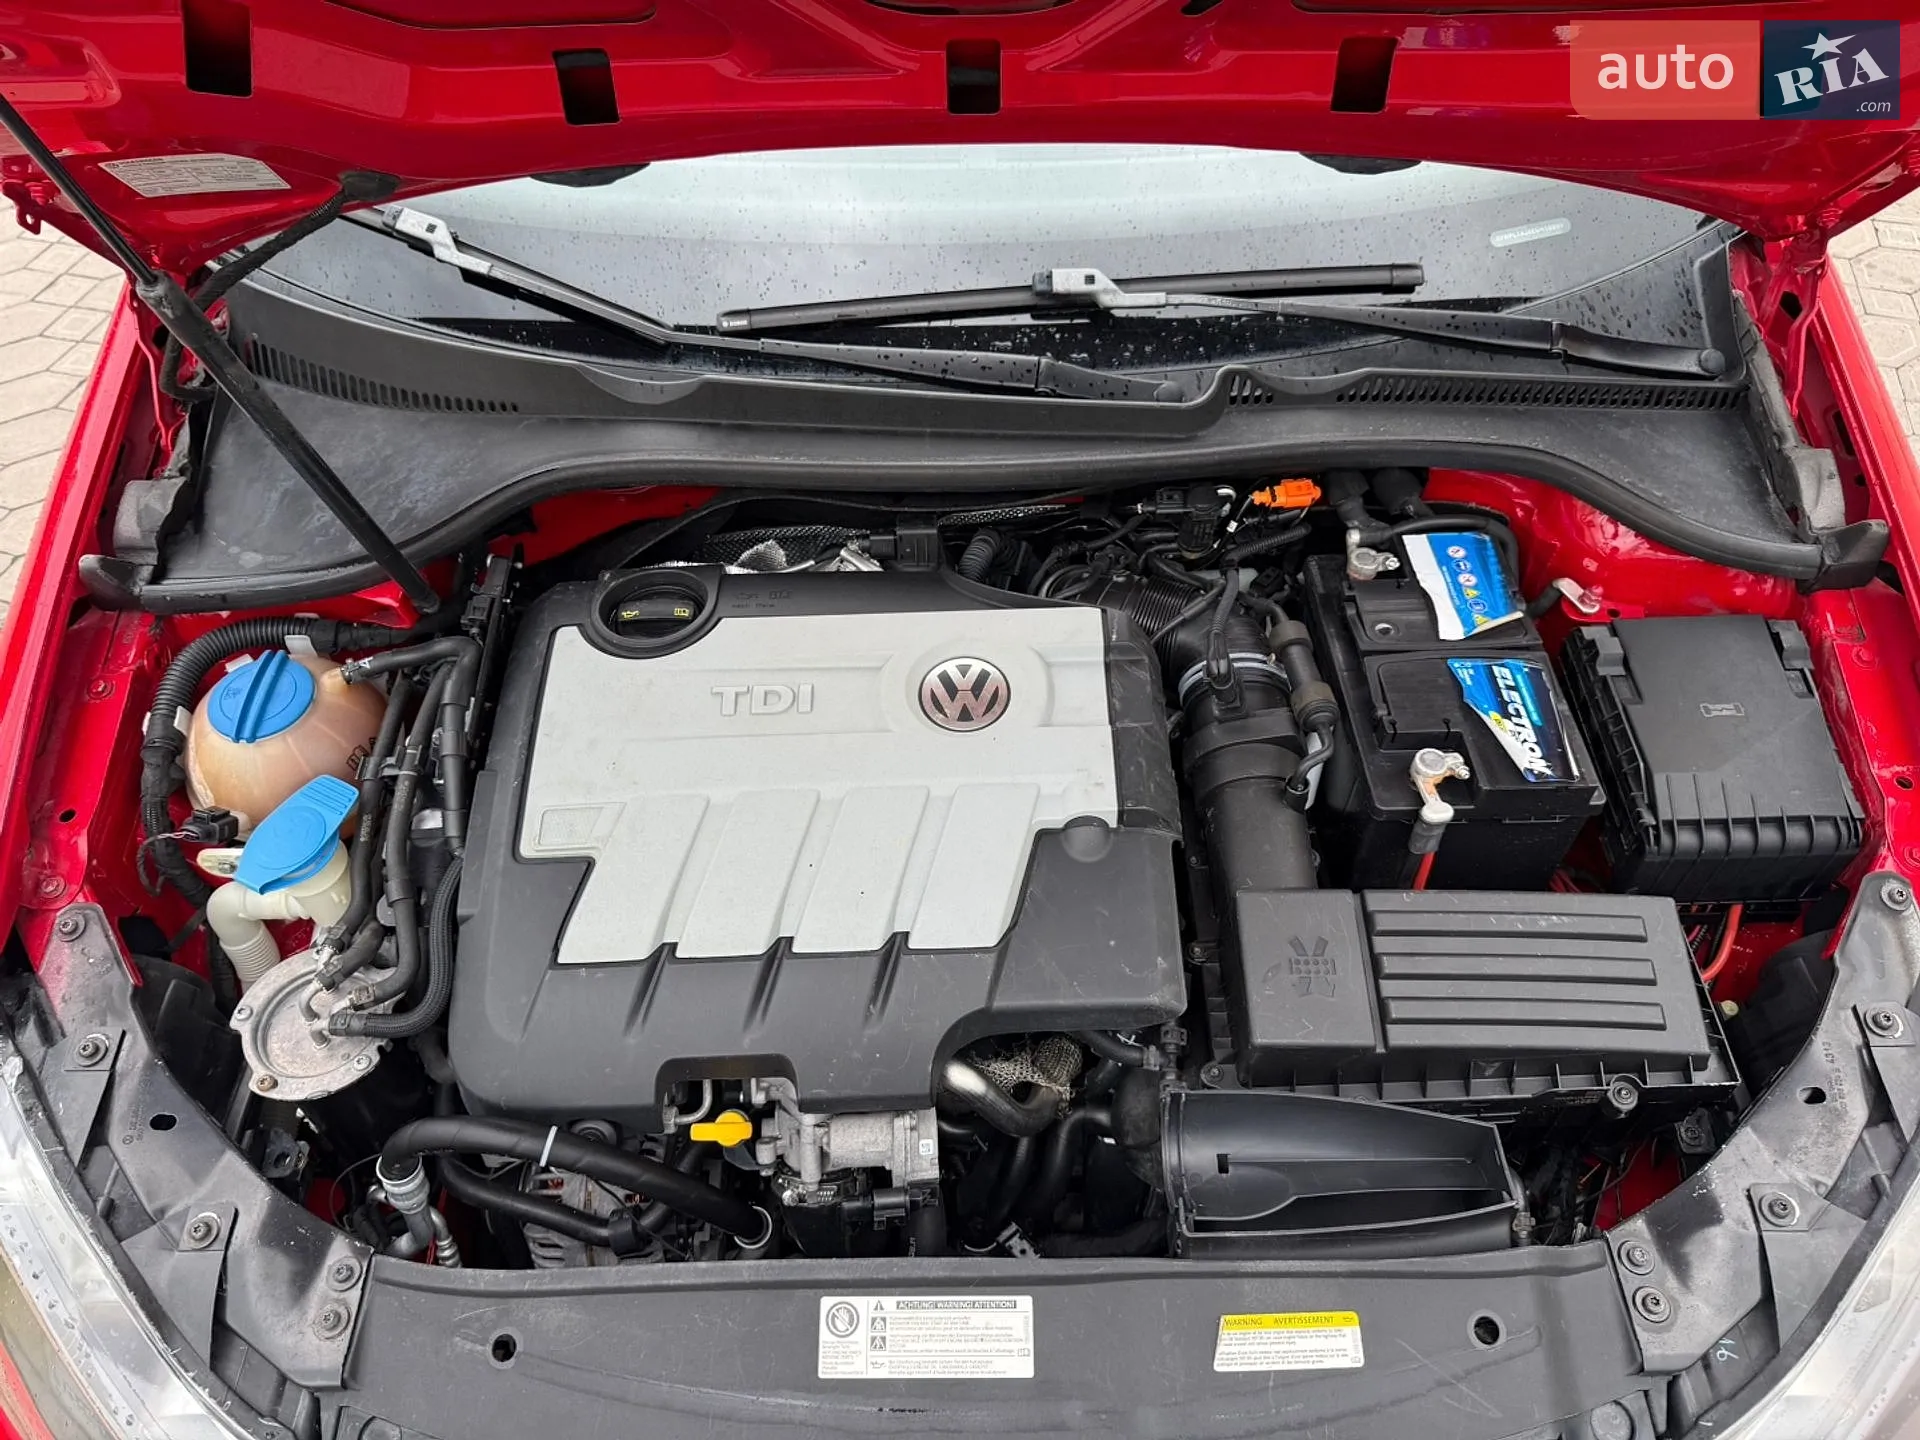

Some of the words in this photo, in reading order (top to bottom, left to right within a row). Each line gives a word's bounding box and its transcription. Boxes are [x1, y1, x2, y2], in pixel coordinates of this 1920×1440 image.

[710, 683, 815, 717] TDI
[1491, 665, 1553, 776] ELECTRON
[936, 1300, 972, 1310] WARNING!
[973, 1300, 1017, 1310] ATTENTION!
[1224, 1317, 1263, 1327] WARNING
[1273, 1314, 1334, 1326] AVERTISSEMENT
